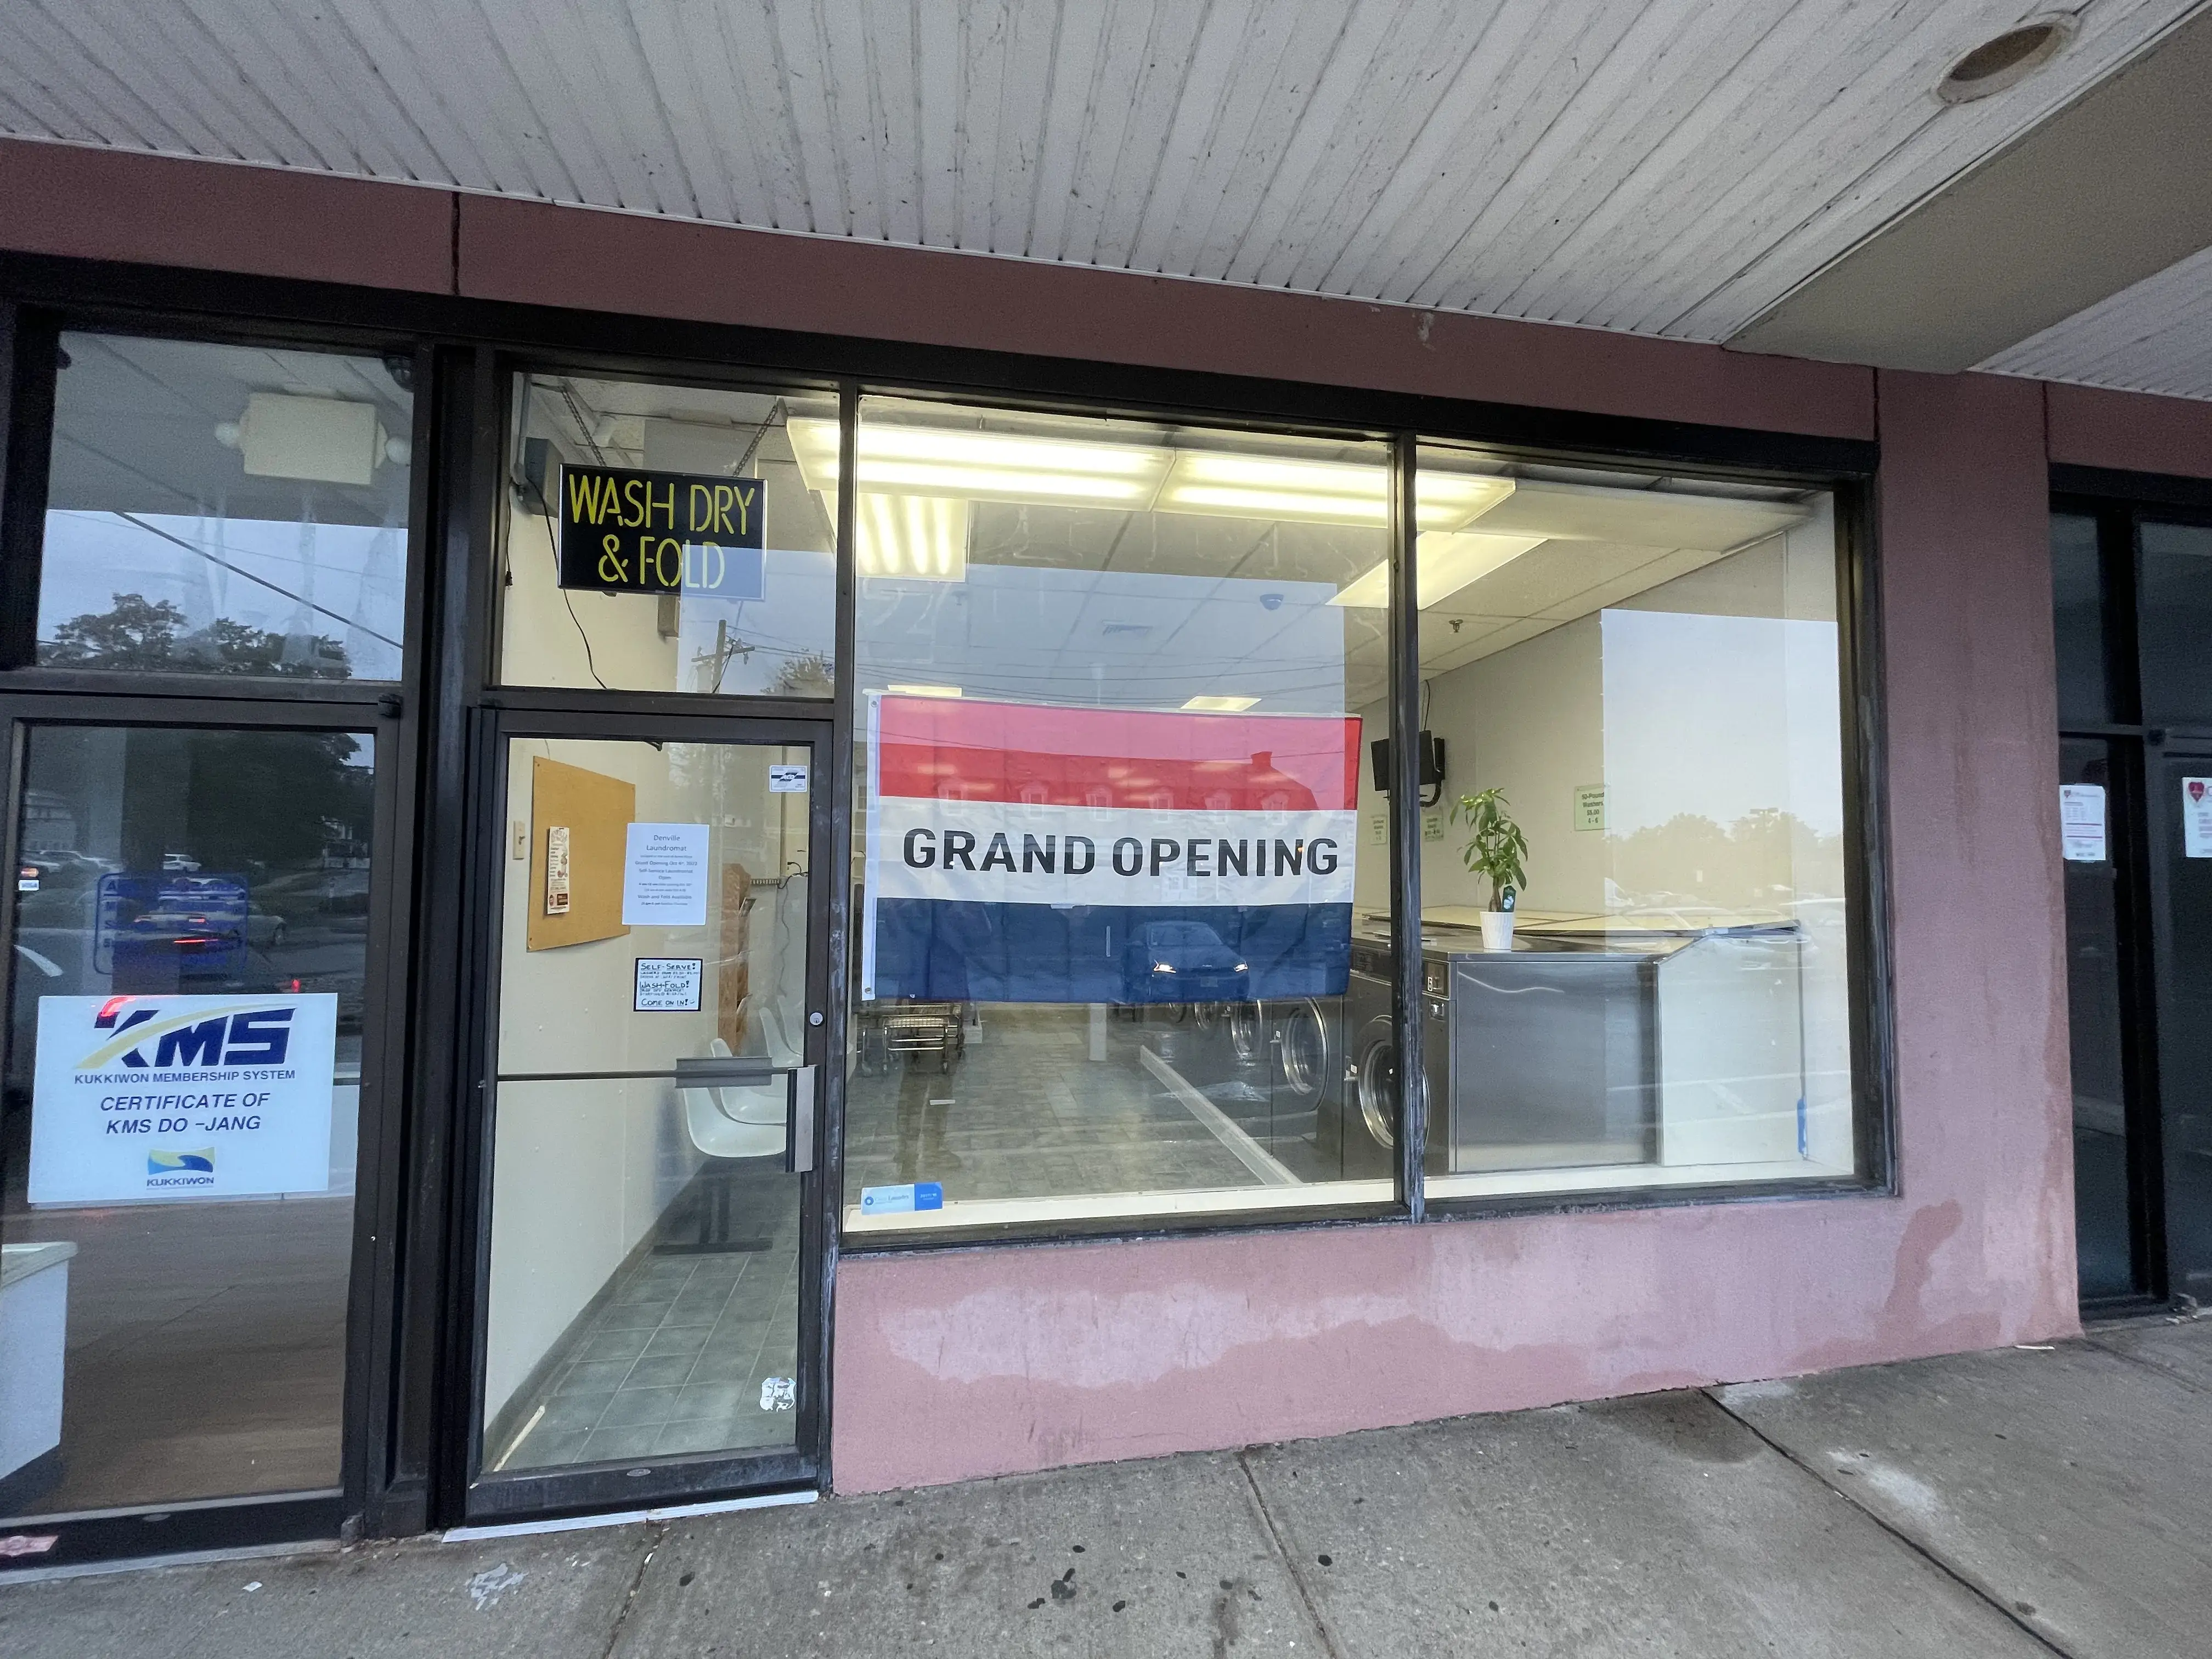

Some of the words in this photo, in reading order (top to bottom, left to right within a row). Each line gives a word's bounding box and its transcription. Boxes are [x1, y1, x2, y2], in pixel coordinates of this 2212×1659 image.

[569, 473, 674, 529] WASH
[690, 484, 755, 535] DRY
[599, 534, 628, 582] &
[640, 536, 725, 589] FOLD
[904, 828, 1096, 875] GRAND
[1112, 837, 1338, 877] OPENING
[94, 1007, 297, 1068] KMS
[74, 1073, 149, 1084] KUKKIWON
[153, 1071, 239, 1082] MEMBERSHIP
[243, 1070, 296, 1080] SYSTEM
[100, 1093, 238, 1111] CERTIFICATE
[242, 1092, 270, 1107] OF
[106, 1119, 152, 1134] KMS
[157, 1118, 189, 1132] DO
[146, 1177, 215, 1187] KUKKIWON
